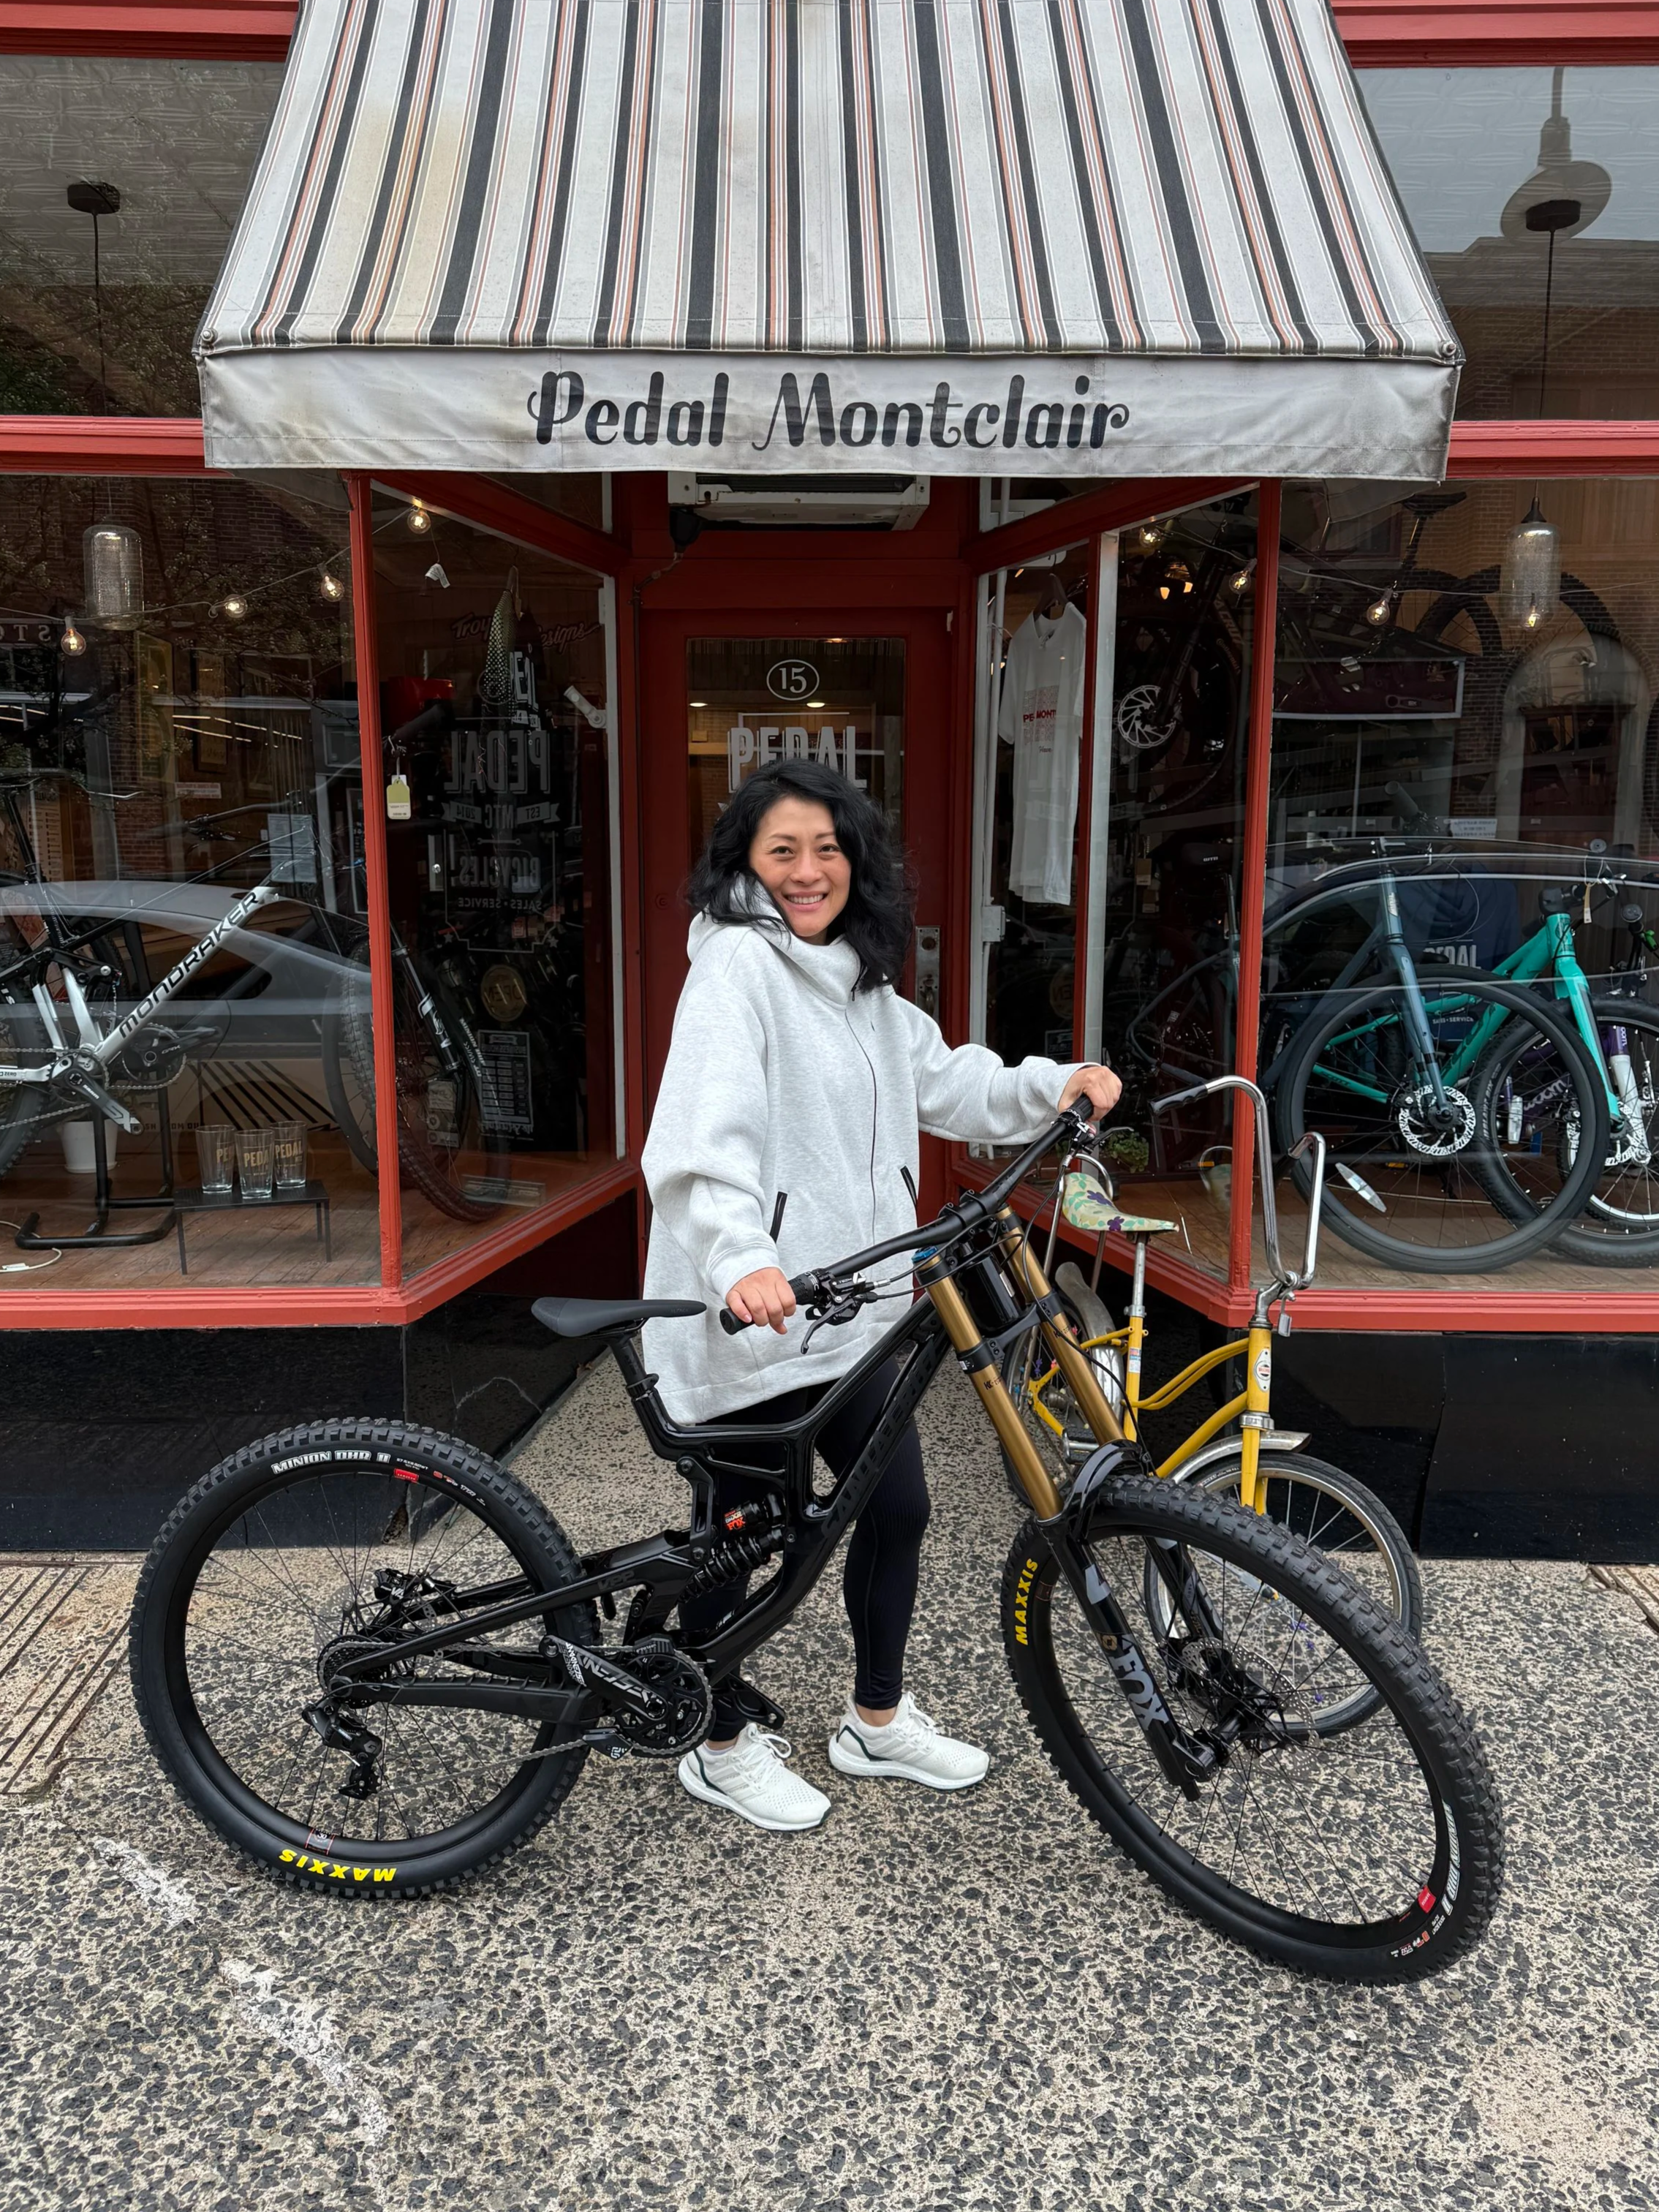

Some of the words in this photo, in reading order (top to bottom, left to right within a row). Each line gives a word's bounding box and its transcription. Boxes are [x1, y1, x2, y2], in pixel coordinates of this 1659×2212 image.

[527, 369, 730, 445] Pedal
[752, 372, 1130, 451] Montclair
[779, 666, 807, 694] 15
[119, 891, 259, 1038] MONDRAKER
[275, 1141, 303, 1159] PEDAL
[271, 1451, 332, 1474] MINION
[727, 1517, 746, 1531] FOX
[1014, 1558, 1039, 1645] MAXXIS
[1111, 1646, 1170, 1731] FOX
[279, 1848, 397, 1883] MAXXIS
